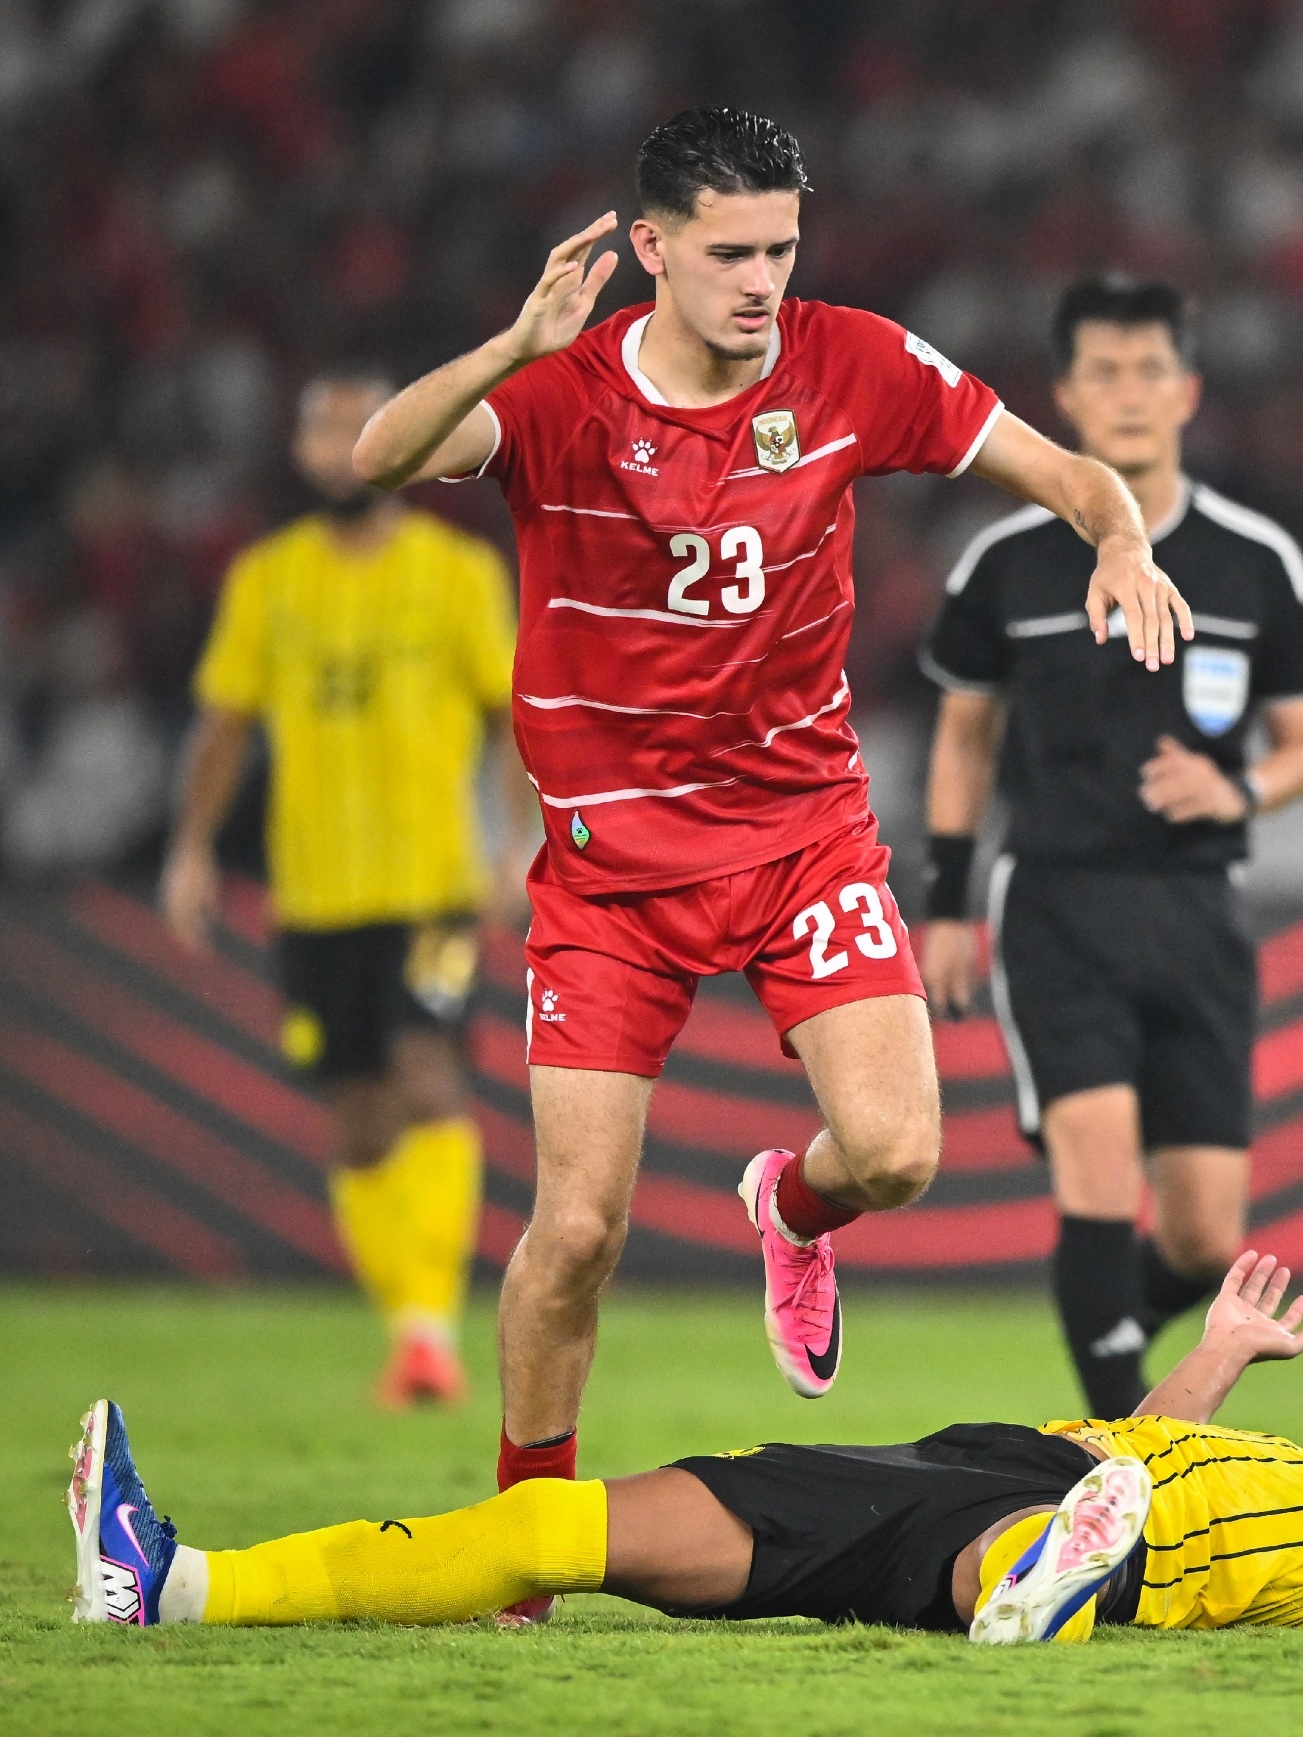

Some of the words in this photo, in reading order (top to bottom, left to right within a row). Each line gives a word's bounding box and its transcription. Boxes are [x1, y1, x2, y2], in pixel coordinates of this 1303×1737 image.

[620, 460, 659, 477] KELME
[667, 525, 766, 616] 23
[792, 882, 898, 979] 23
